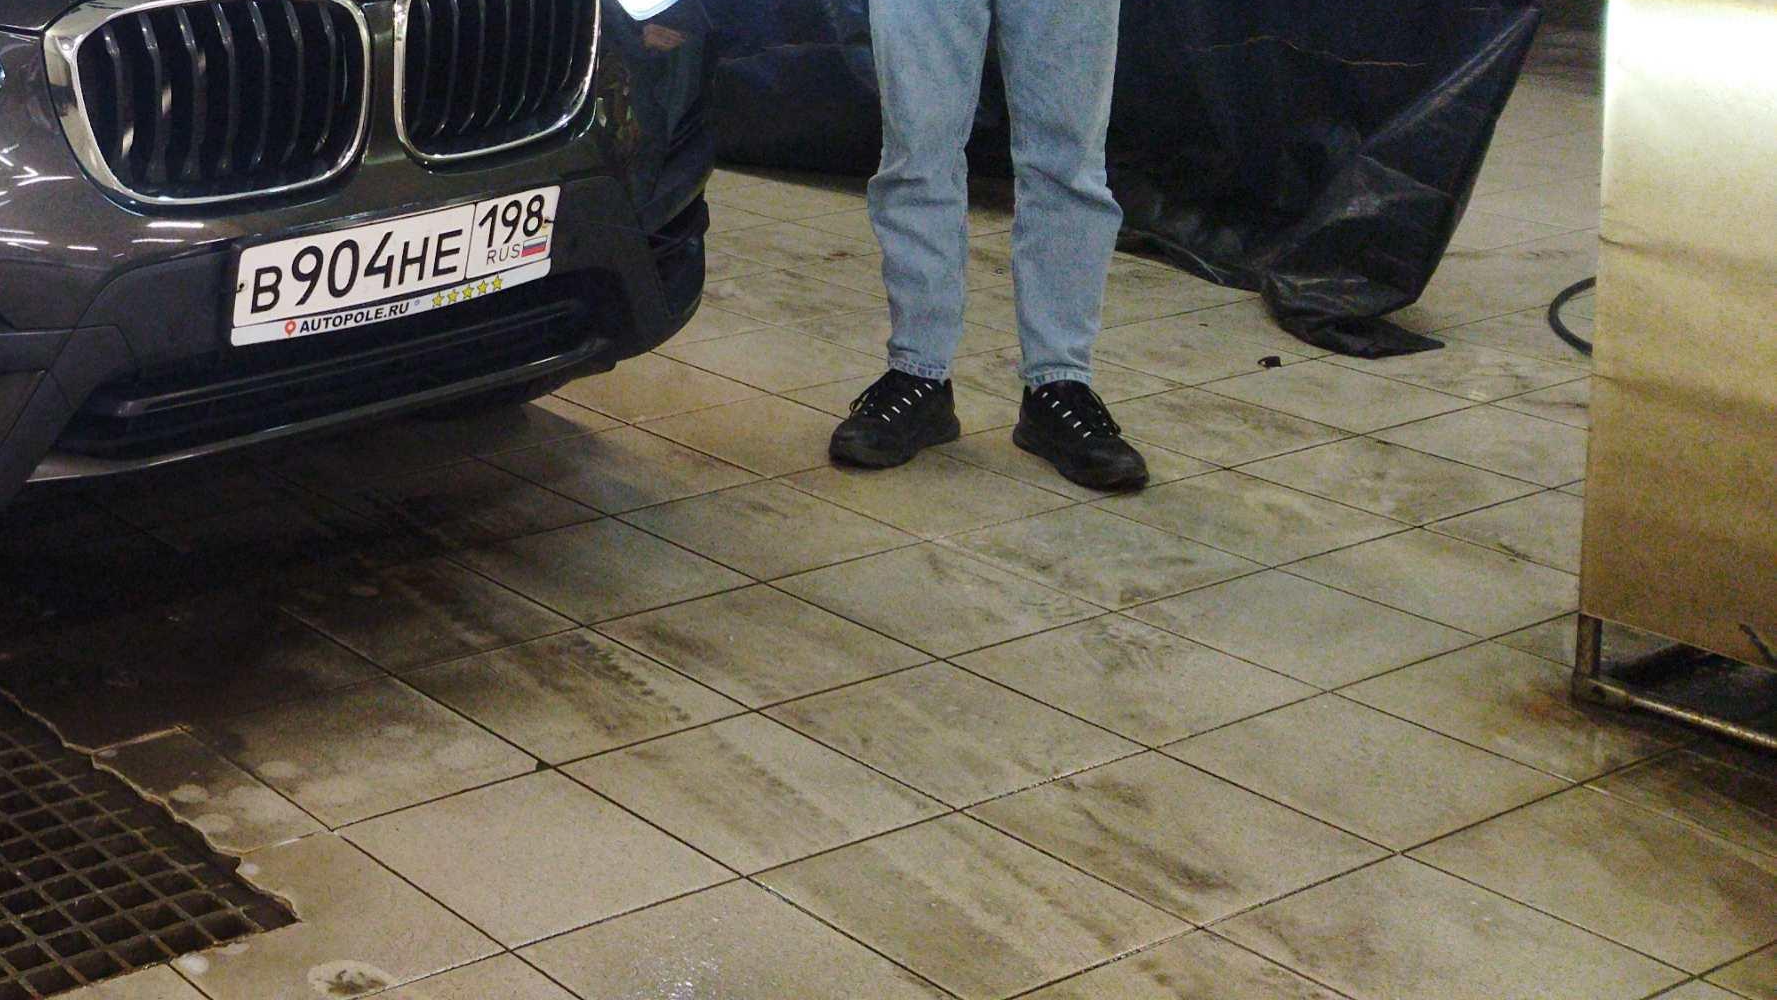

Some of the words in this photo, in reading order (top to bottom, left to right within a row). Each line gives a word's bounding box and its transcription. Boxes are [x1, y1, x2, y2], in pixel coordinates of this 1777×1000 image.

[478, 193, 545, 249] 198
[485, 242, 521, 265] RUS
[298, 302, 410, 333] AUTOPOLE.RU
